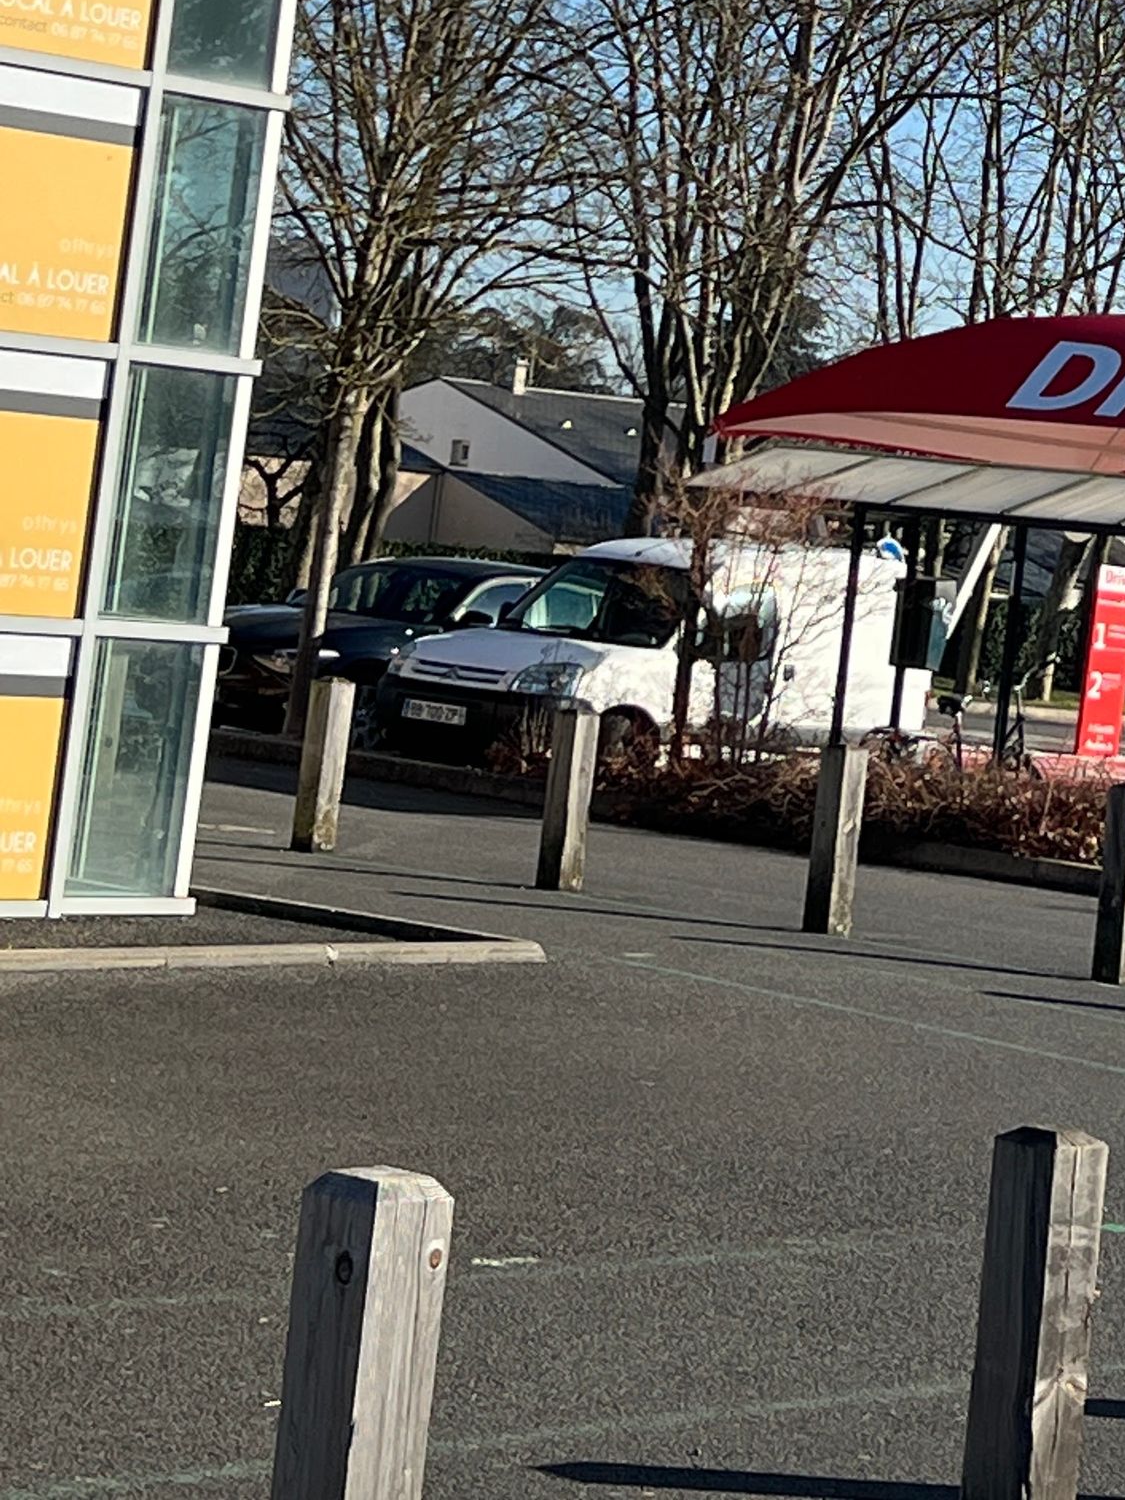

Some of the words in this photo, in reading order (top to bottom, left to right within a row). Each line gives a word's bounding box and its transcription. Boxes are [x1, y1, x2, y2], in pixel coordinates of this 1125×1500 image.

[80, 1, 142, 29] LOUER
[46, 267, 109, 295] LOUER
[10, 546, 73, 572] LOUER
[1092, 622, 1107, 651] 1
[1087, 670, 1103, 699] 2
